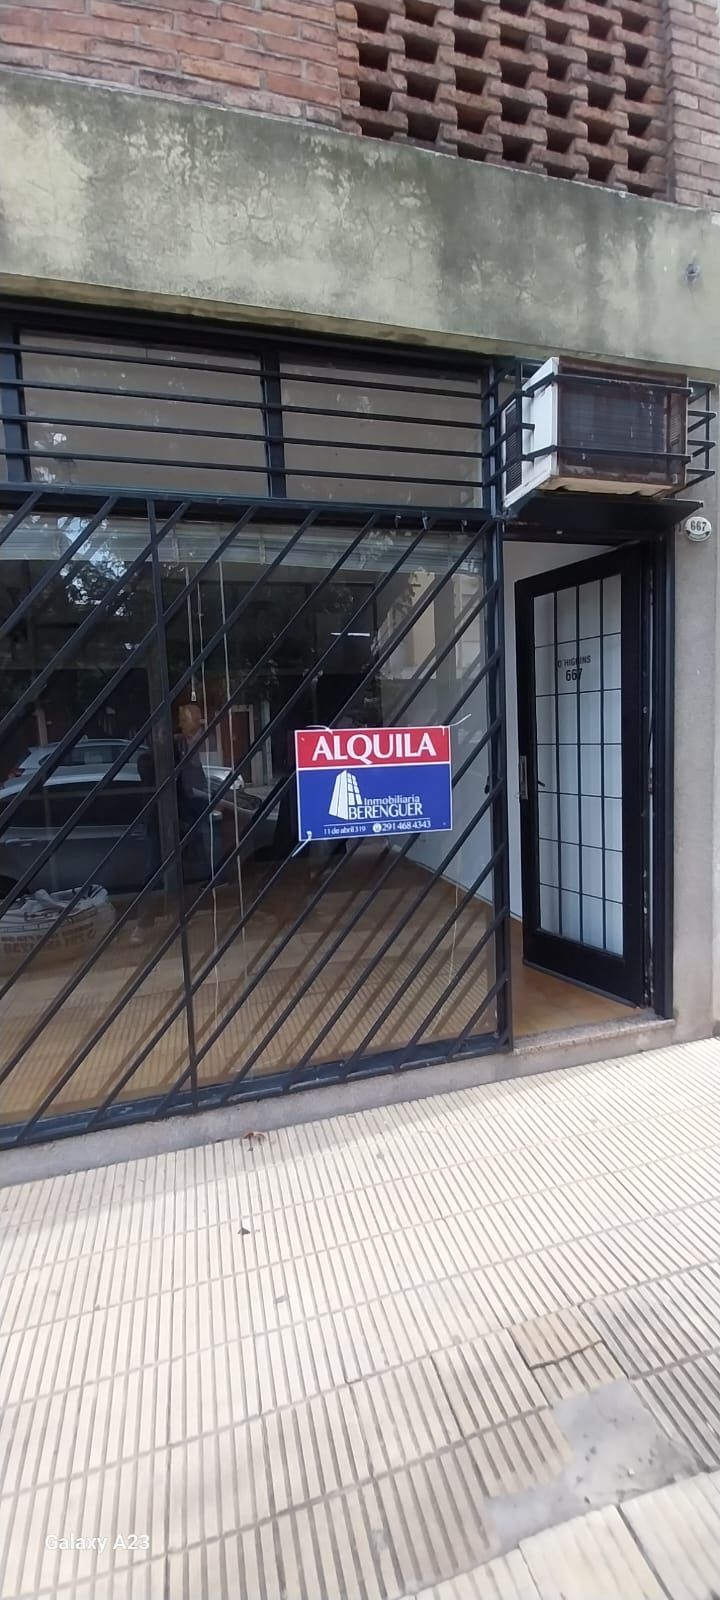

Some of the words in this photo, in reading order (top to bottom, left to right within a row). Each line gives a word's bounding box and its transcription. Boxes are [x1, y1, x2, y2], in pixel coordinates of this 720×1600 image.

[690, 520, 707, 531] 667
[557, 655, 591, 668] O'HIGINS
[311, 732, 437, 765] ALQUILA
[364, 793, 421, 806] Inmobiliaria
[348, 802, 424, 820] BERENGUER
[331, 827, 339, 835] de
[340, 826, 354, 834] abril
[354, 825, 366, 833] 319
[381, 823, 396, 832] 291
[397, 822, 412, 831] 468
[412, 820, 431, 831] 4343
